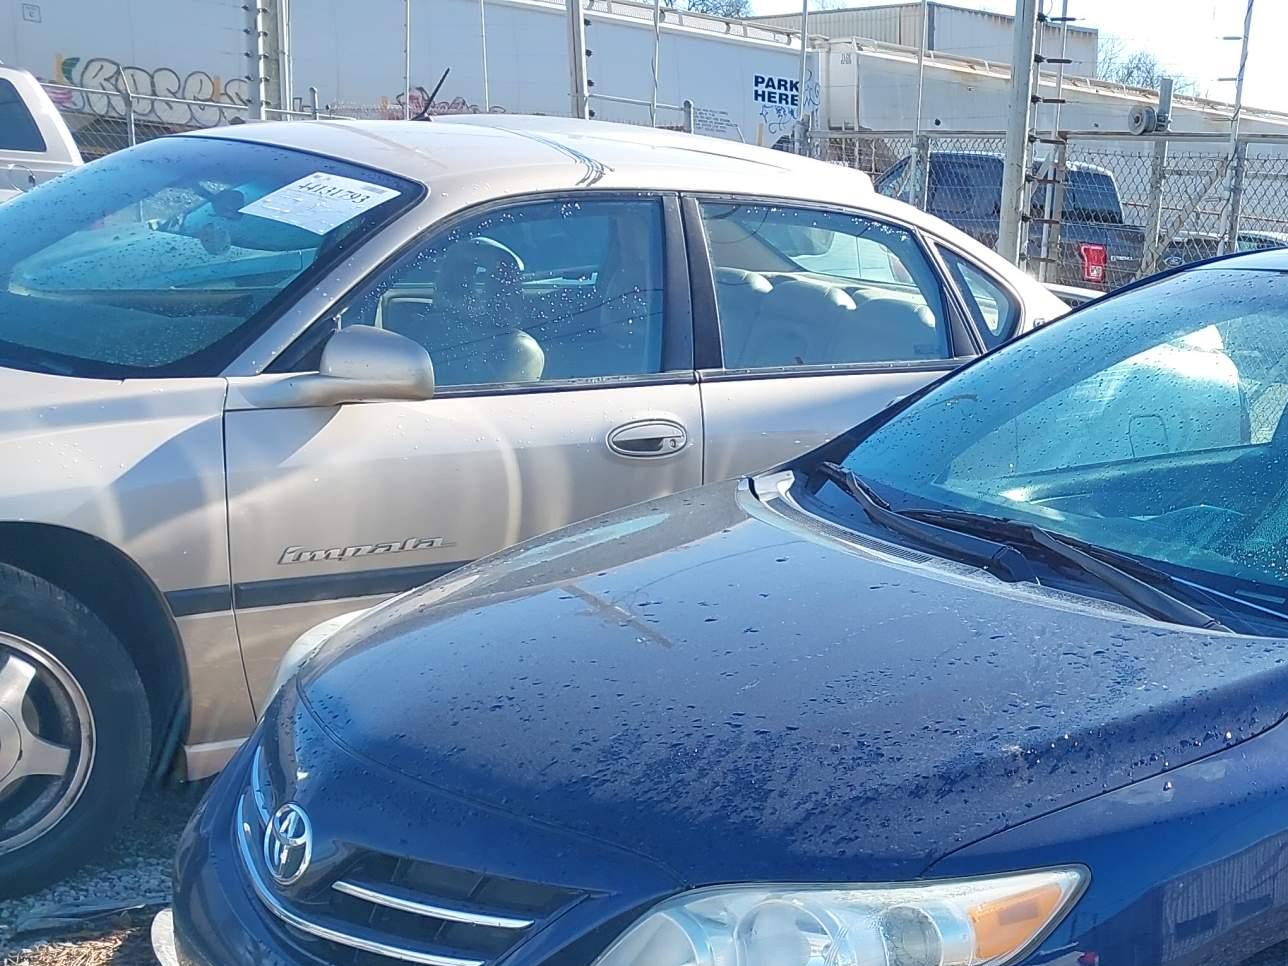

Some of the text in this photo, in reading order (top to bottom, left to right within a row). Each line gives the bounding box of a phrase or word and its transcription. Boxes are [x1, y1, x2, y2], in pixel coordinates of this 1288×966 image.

[754, 74, 799, 92] PARK
[754, 89, 799, 107] HERE
[297, 181, 371, 204] 44131793
[278, 536, 456, 565] Impala
